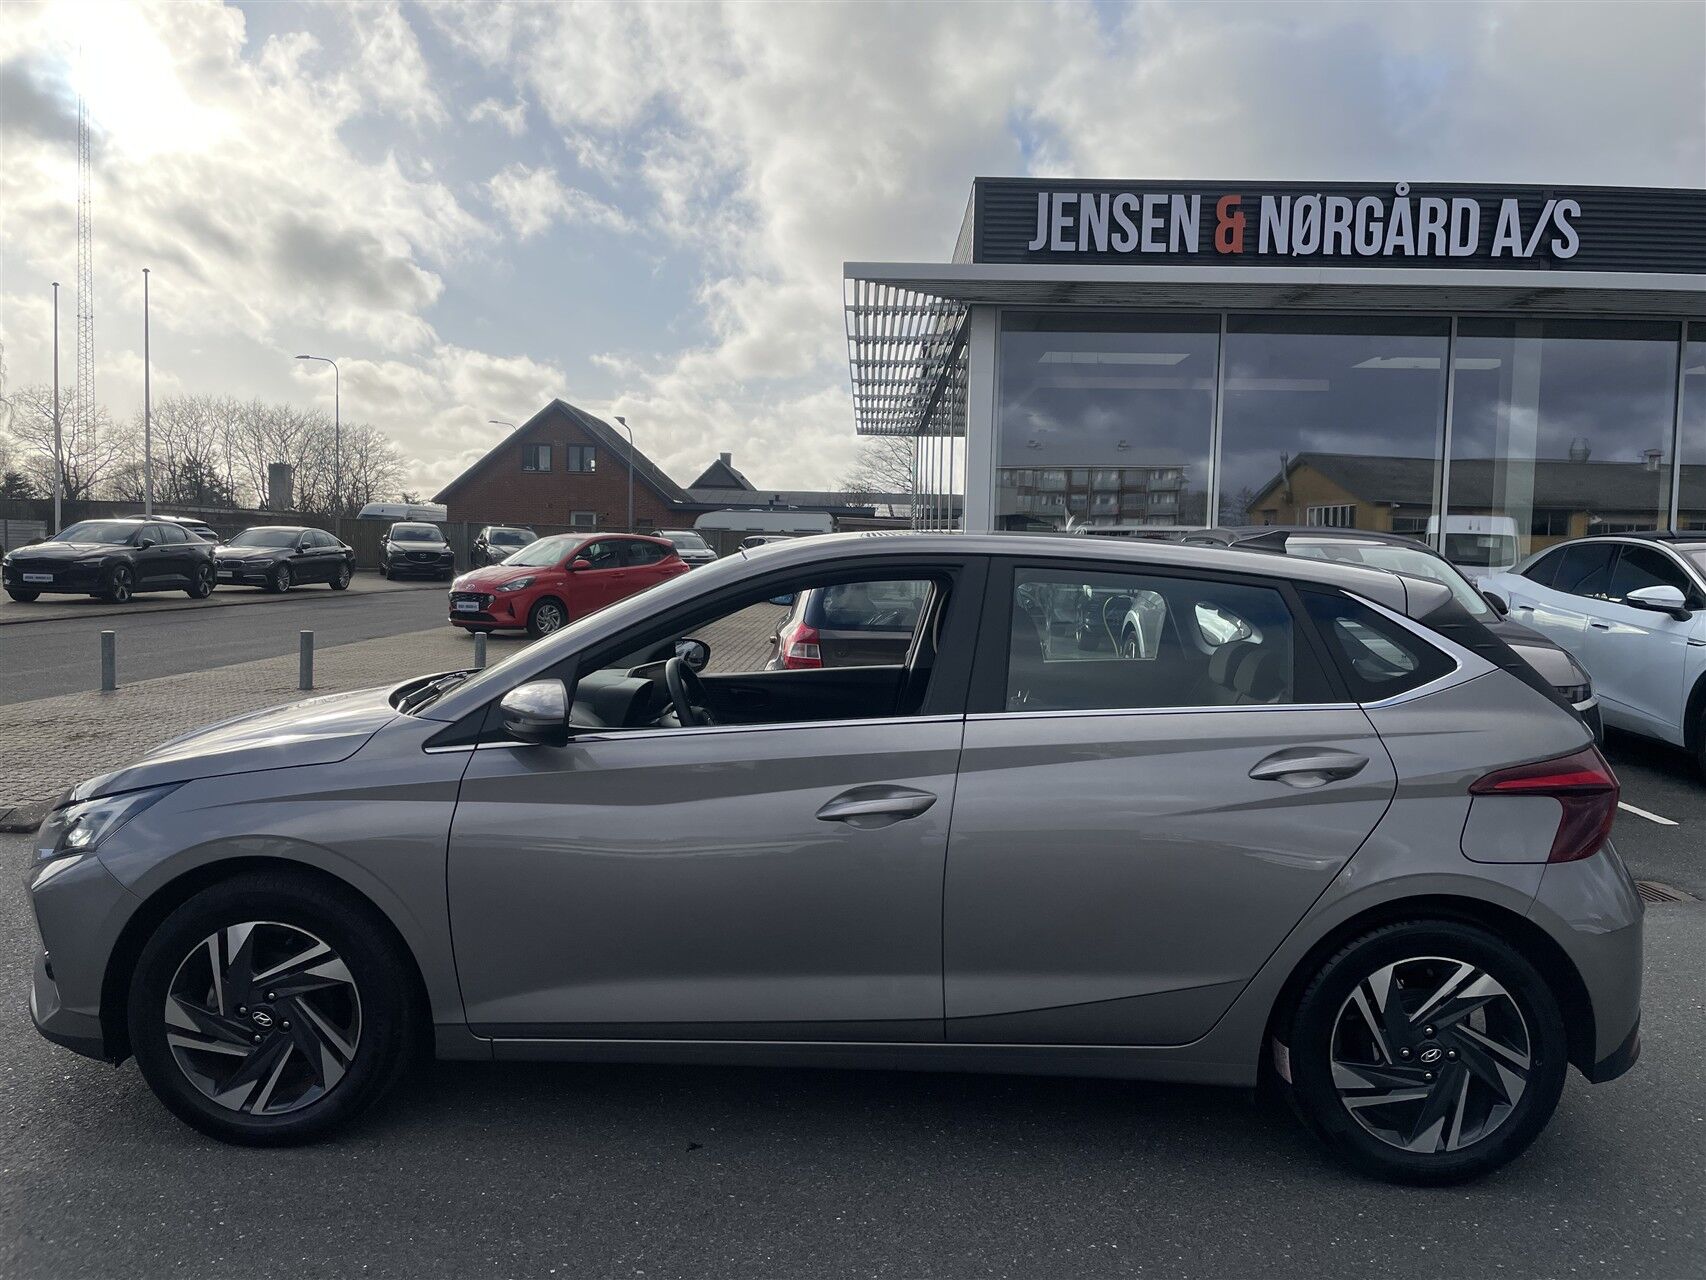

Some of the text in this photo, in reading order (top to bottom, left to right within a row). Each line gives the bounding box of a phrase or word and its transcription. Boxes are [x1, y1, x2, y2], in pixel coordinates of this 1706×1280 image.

[1029, 182, 1581, 259] JENSEN & NØRGÅRD A/S
